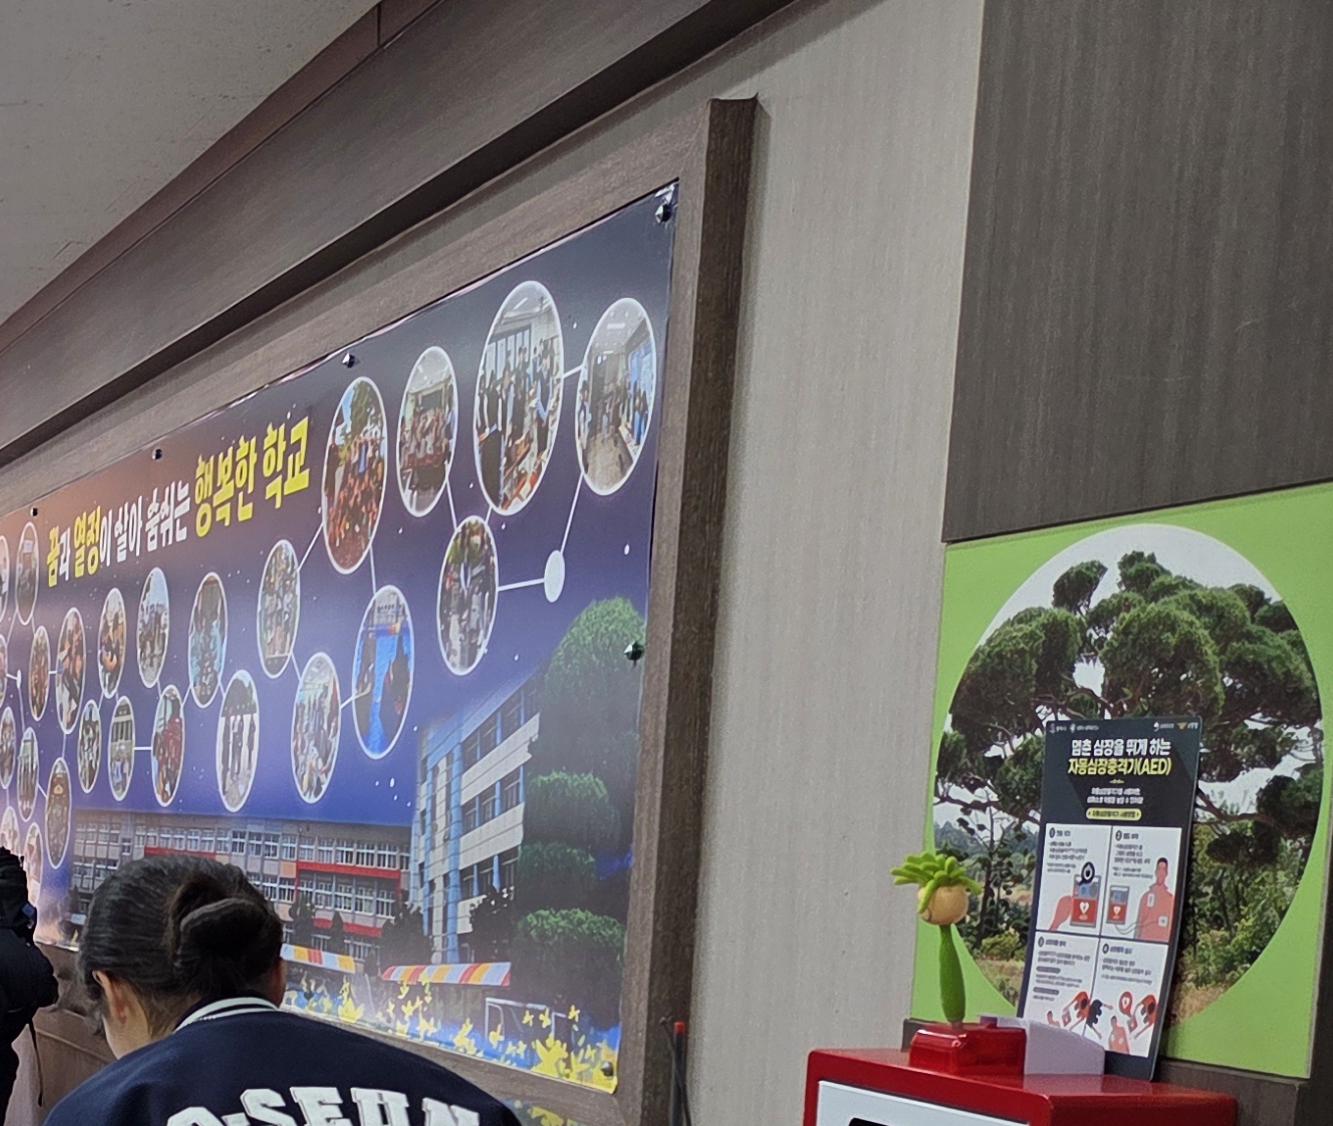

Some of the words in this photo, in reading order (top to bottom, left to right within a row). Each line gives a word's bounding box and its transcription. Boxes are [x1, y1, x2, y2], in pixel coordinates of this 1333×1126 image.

[46, 525, 71, 588] 꿈과
[73, 505, 113, 578] 열정이
[114, 495, 143, 563] 살아
[145, 480, 190, 552] 숨쉬는
[195, 434, 257, 538] 행복한
[262, 416, 310, 510] 학교
[1072, 738, 1092, 756] 멈춘
[1093, 738, 1124, 756] 심장을
[1149, 738, 1171, 756] 하는
